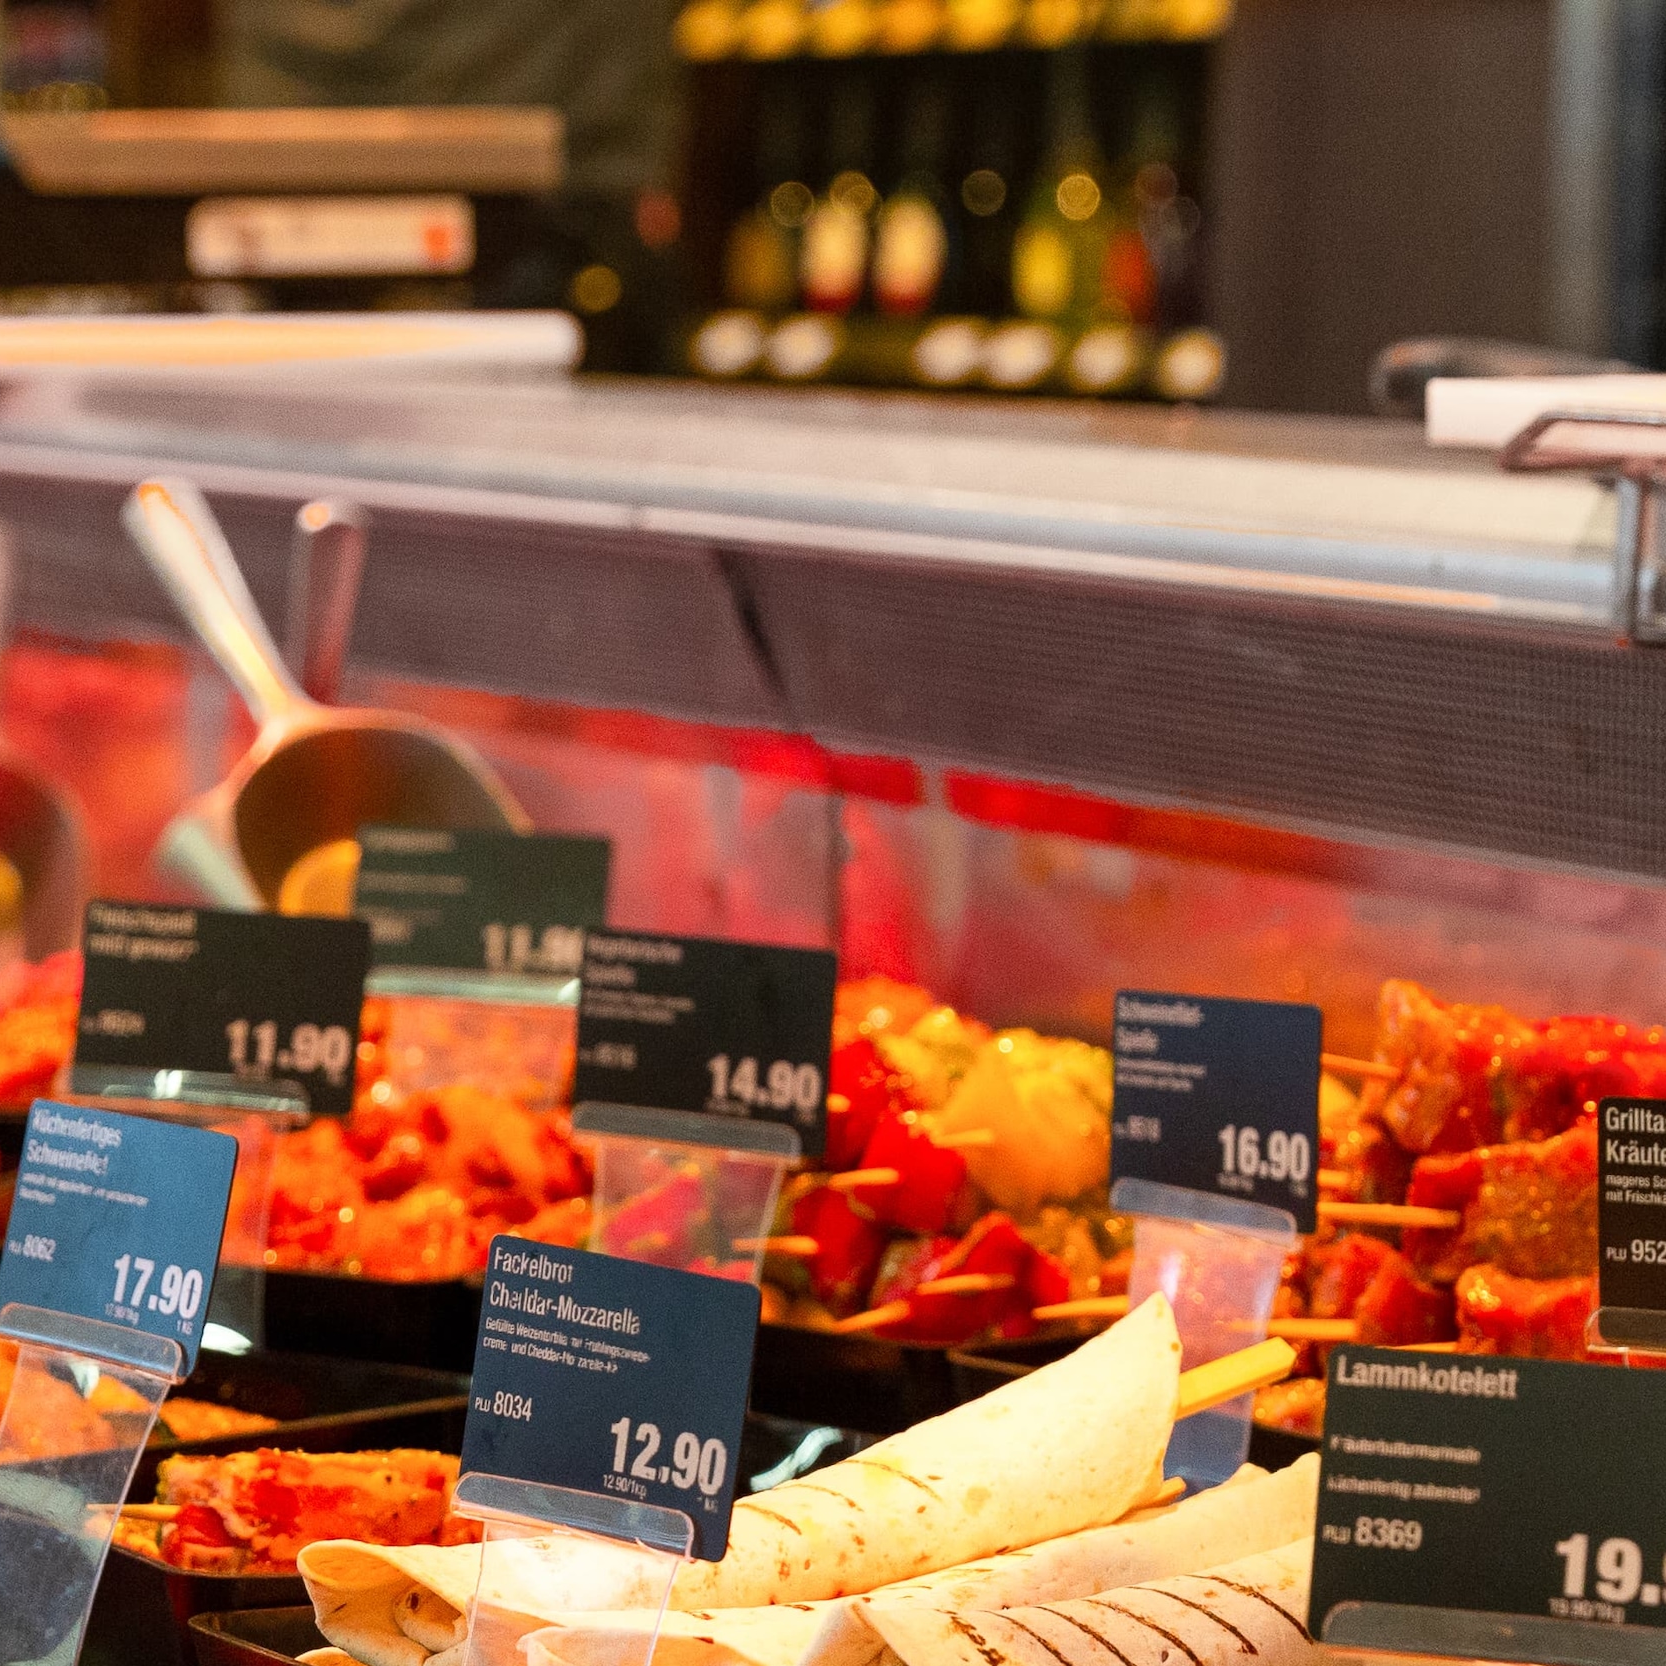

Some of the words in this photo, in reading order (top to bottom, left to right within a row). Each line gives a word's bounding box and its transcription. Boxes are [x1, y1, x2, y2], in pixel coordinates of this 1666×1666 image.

[225, 1018, 352, 1073] 11.90
[708, 1053, 822, 1110] 14.90
[1218, 1123, 1310, 1182] 16.90
[1605, 1173, 1651, 1190] mageres
[1605, 1190, 1623, 1203] mit
[494, 1247, 574, 1283] Fackelbrot
[1606, 1246, 1627, 1261] PLU
[113, 1253, 204, 1320] 17.90
[511, 1340, 527, 1356] und
[1337, 1354, 1518, 1400] Lammkotelett
[475, 1397, 490, 1412] PLU
[493, 1391, 532, 1422] 8034
[1355, 1516, 1423, 1552] 8369
